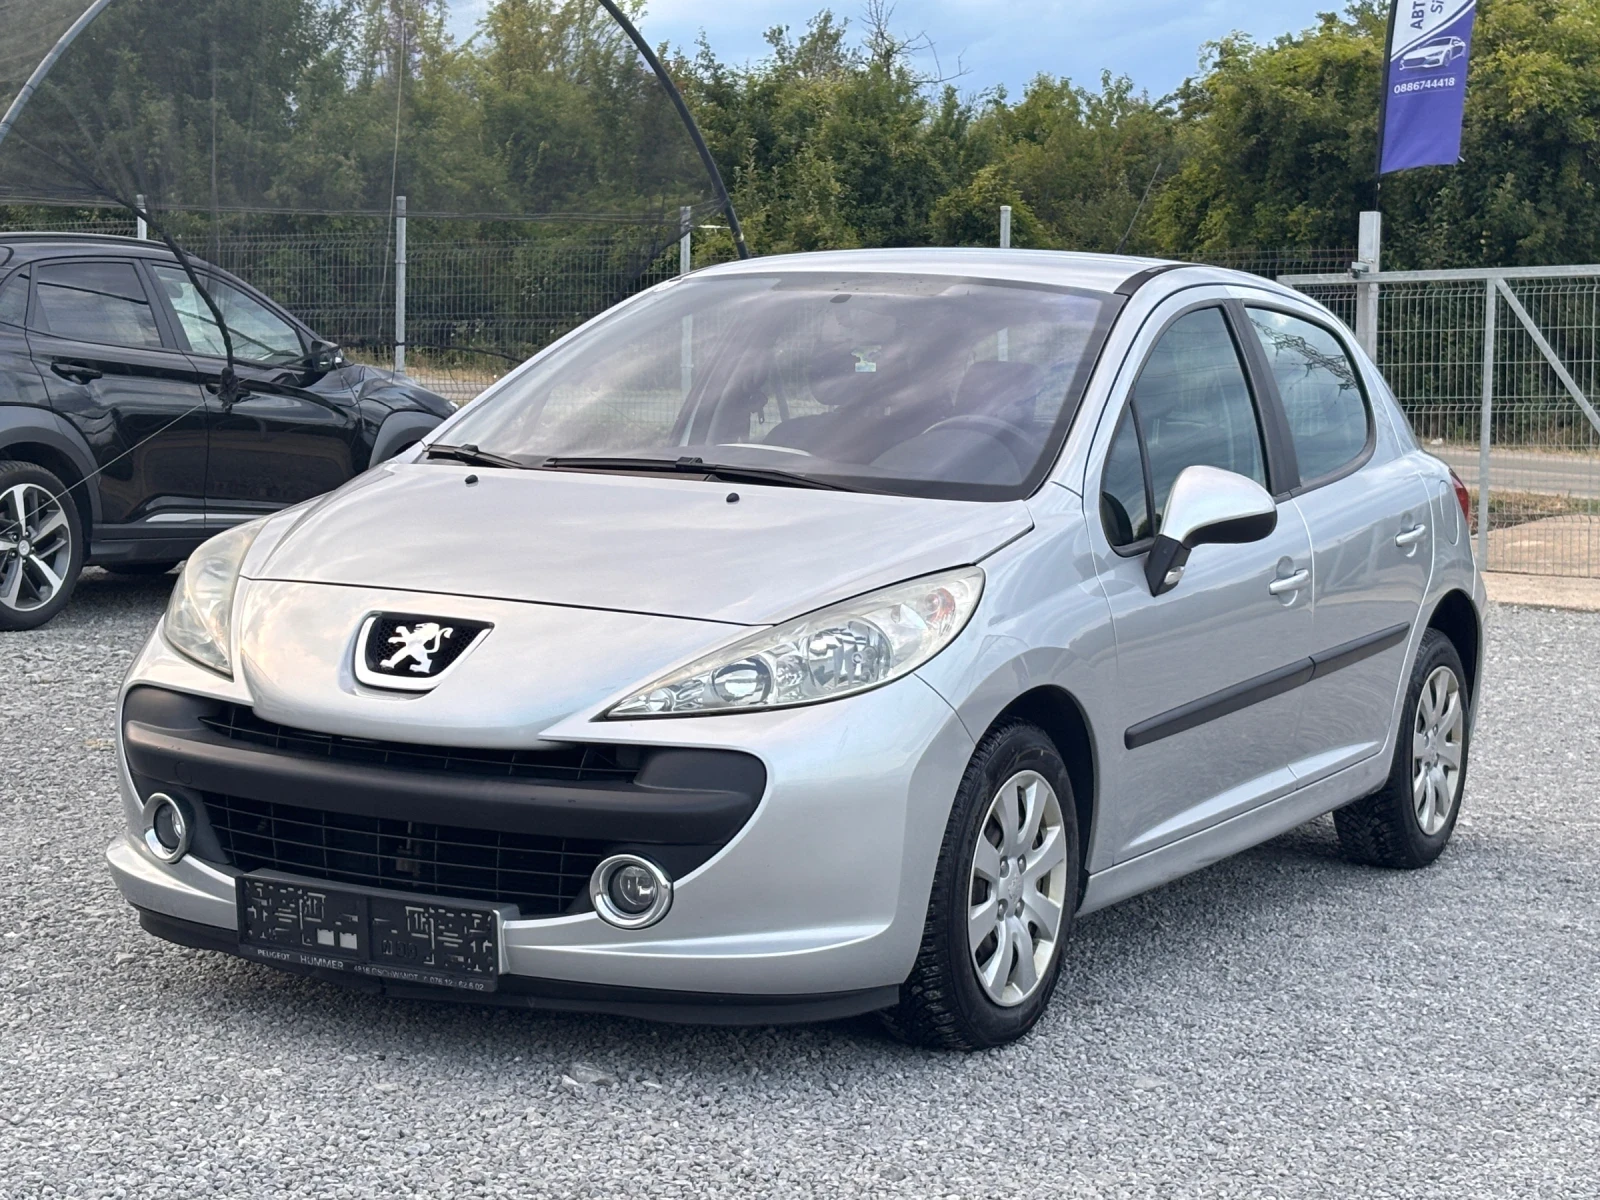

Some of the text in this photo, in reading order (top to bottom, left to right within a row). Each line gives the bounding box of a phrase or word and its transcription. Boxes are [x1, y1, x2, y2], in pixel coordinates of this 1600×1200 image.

[1410, 0, 1426, 30] АВТ
[1393, 77, 1456, 94] 0886744418
[257, 949, 291, 960] PEUGEOT
[300, 955, 344, 971] HUMMER
